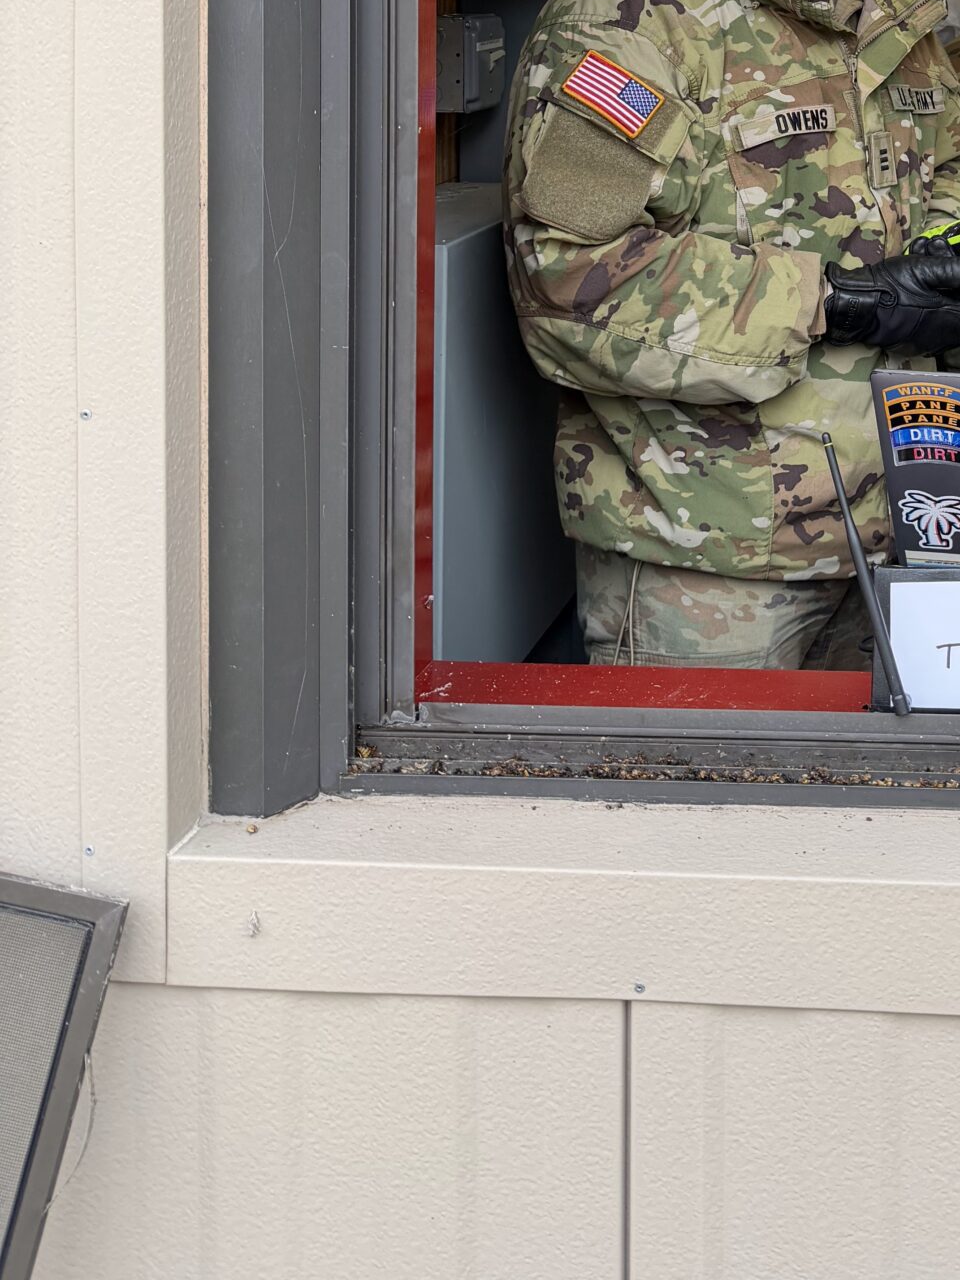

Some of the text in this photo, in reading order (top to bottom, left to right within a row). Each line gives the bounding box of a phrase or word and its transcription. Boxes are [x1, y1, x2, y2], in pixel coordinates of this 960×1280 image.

[774, 108, 829, 134] OWENS
[897, 386, 954, 397] WANT-F
[901, 400, 956, 412] PANE
[903, 414, 958, 426] PANE
[910, 428, 955, 443] DIRT
[913, 448, 958, 462] DIRT
